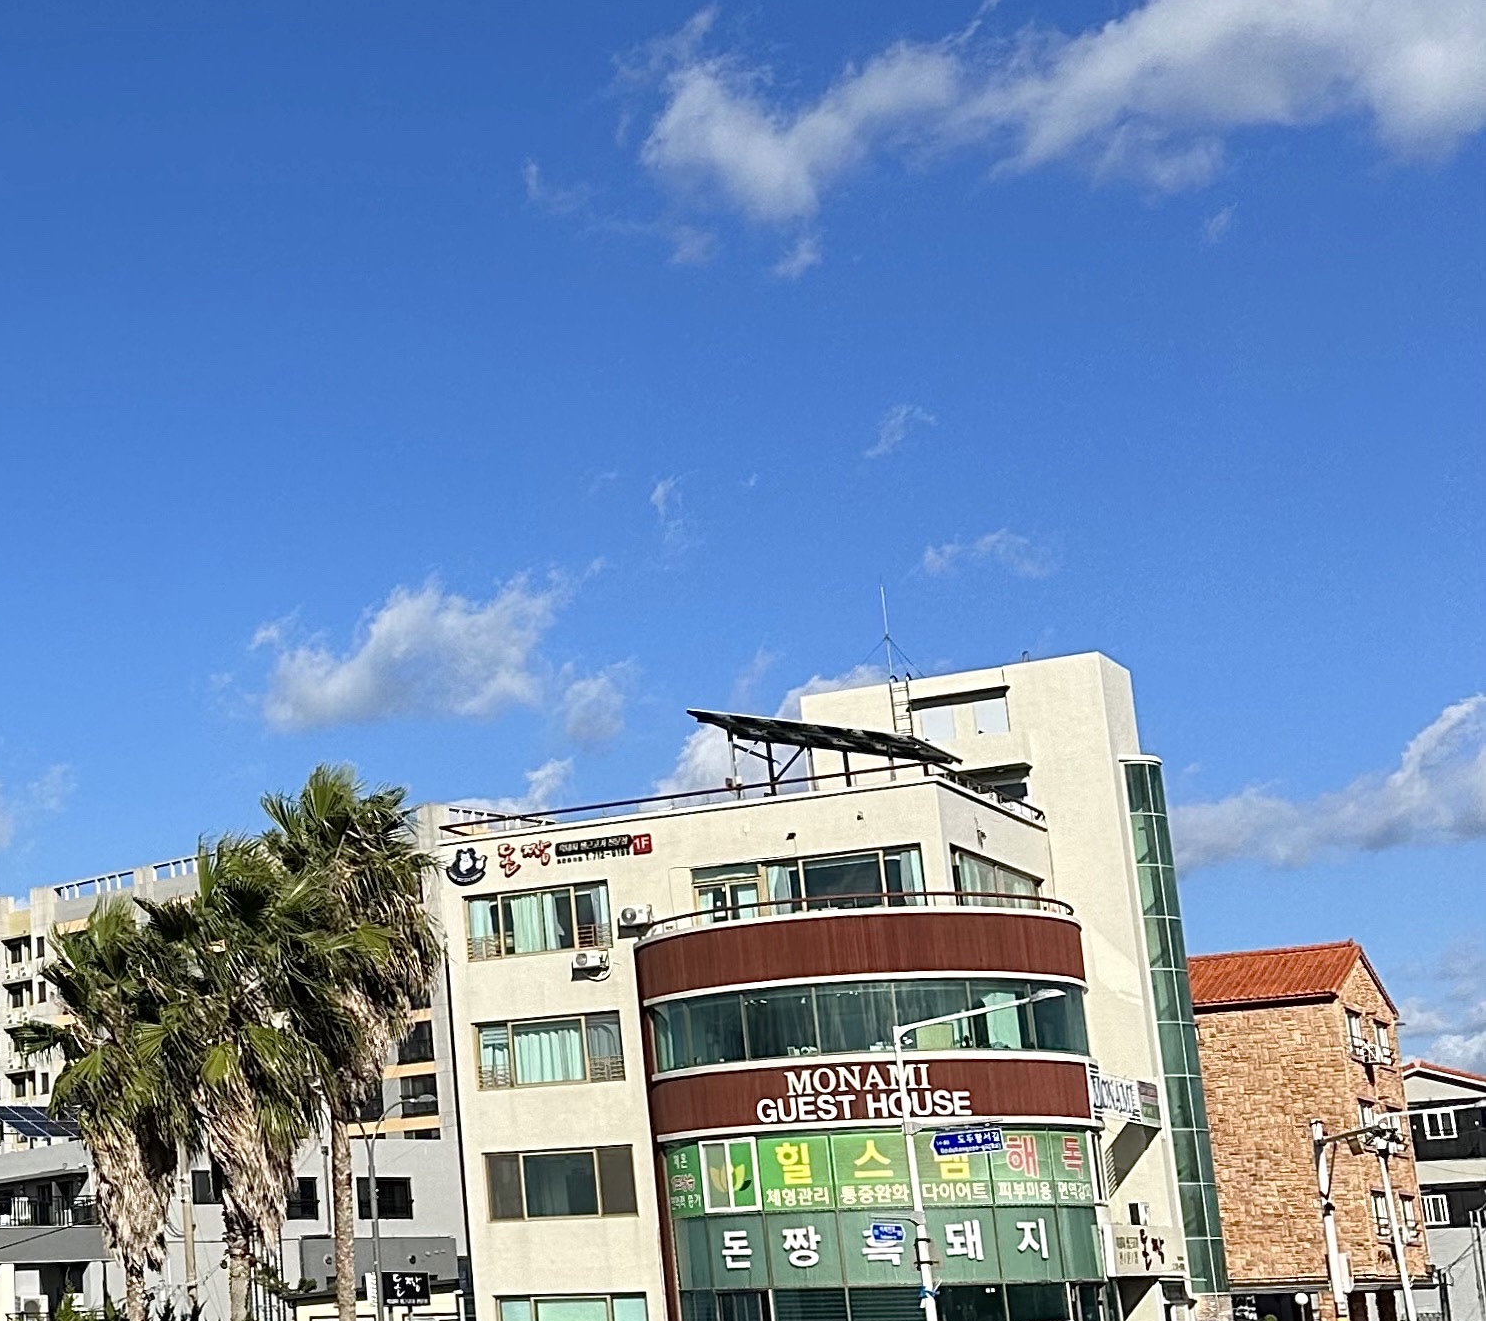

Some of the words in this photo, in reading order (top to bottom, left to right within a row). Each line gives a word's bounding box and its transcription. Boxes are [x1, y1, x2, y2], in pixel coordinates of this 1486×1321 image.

[497, 840, 552, 878] 돈짱
[634, 836, 650, 850] 1F
[783, 1063, 932, 1096] MONAMI
[756, 1094, 856, 1123] GUEST
[866, 1089, 973, 1119] HOUSE
[765, 1185, 830, 1208] 체형관리
[840, 1182, 910, 1205] 통증완화
[921, 1182, 989, 1202] 다이어트
[997, 1181, 1052, 1202] 피부미용
[721, 1225, 822, 1270] 돈짱
[861, 1217, 1050, 1266] 흑돼지
